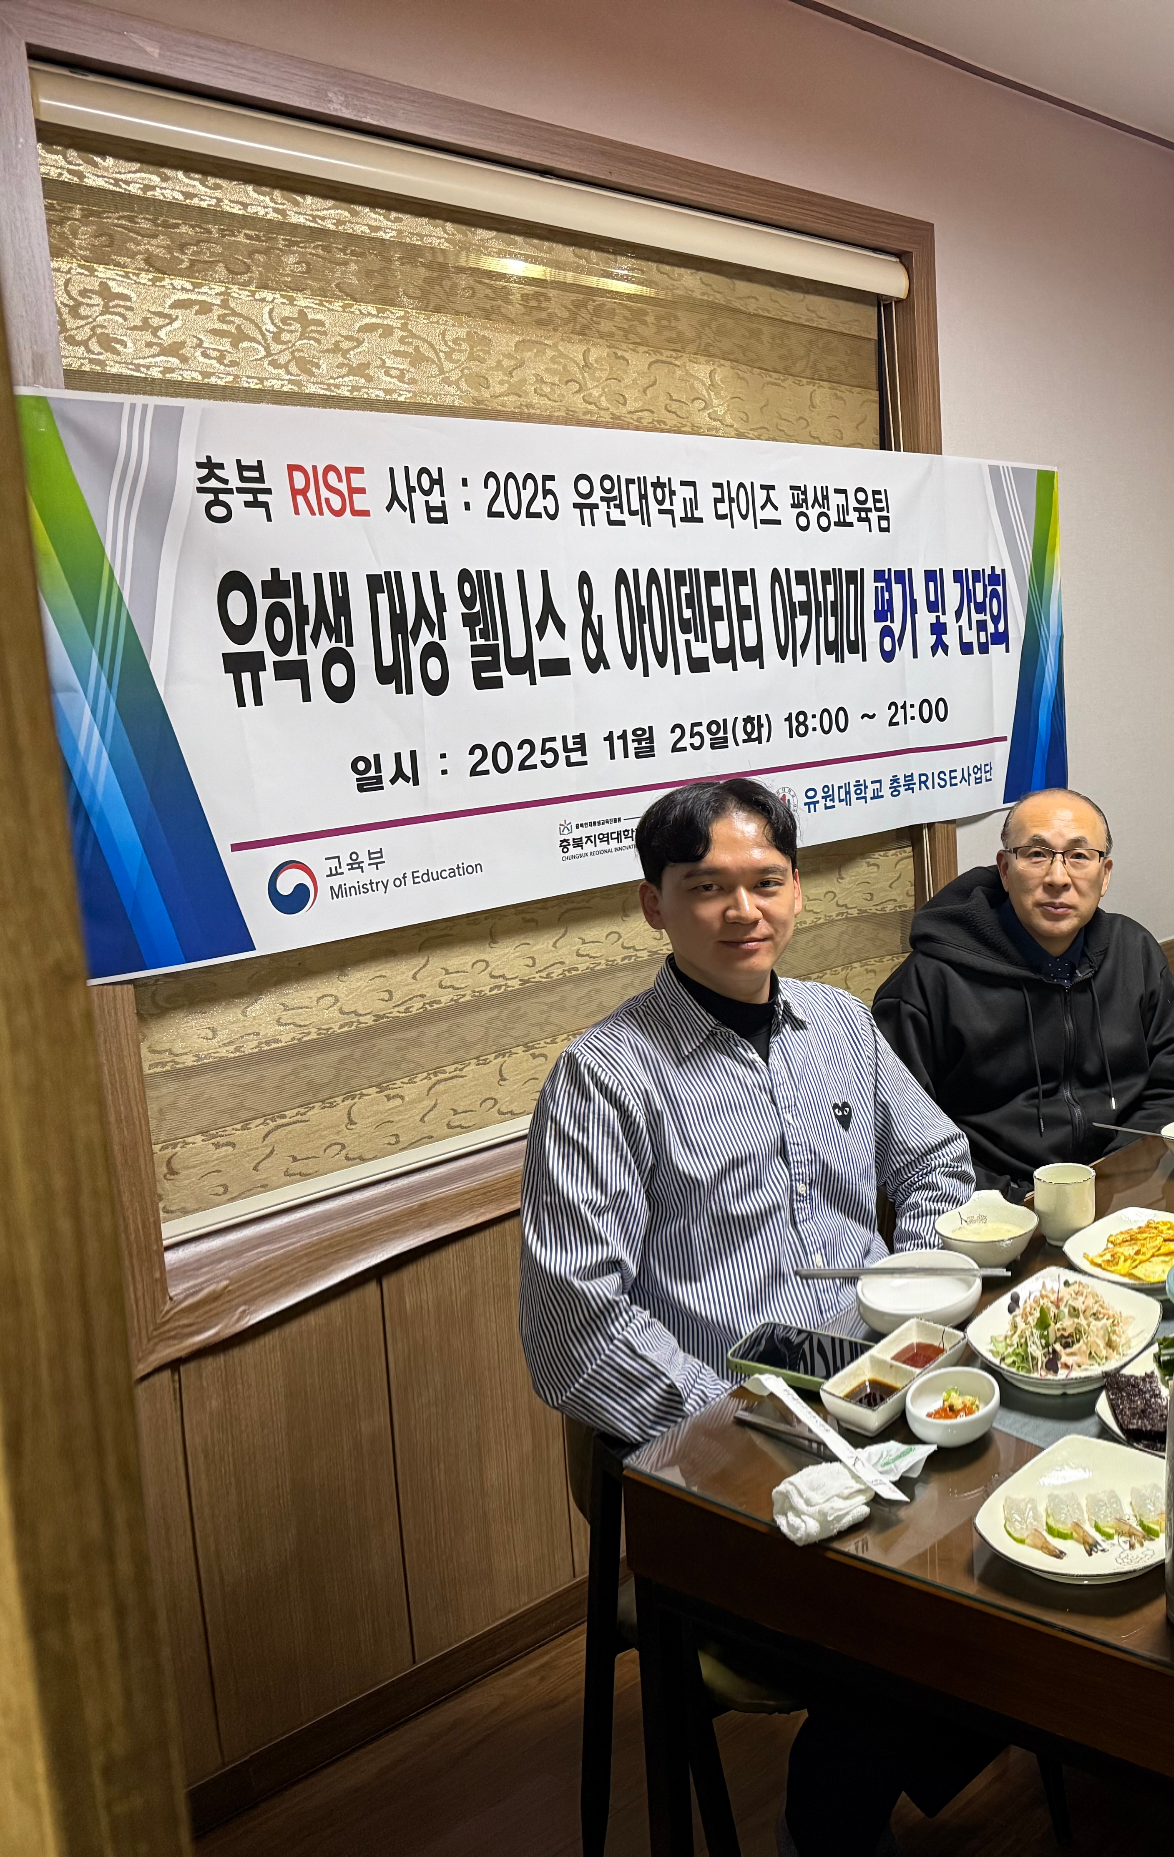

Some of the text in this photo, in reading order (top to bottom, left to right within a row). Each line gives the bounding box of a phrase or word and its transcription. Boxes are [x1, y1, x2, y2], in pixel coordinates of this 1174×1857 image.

[195, 455, 890, 533] 충북 RISE 사업 : 2025 유원대학교 라이즈 평생교육팀
[217, 565, 1010, 708] 유학생 대상 웰니스 & 아이덴티티 아카데미 평가 및 간담회
[351, 750, 419, 793] 일시
[440, 753, 448, 775] :
[468, 733, 588, 777] 2025년
[603, 726, 655, 760] 11월
[670, 714, 772, 753] 25일(화)
[784, 706, 849, 738] 18:00
[888, 697, 948, 727] 21:00
[325, 847, 386, 878] 교육부
[559, 828, 637, 854] 충북지역대학
[329, 860, 484, 900] Ministry of Education
